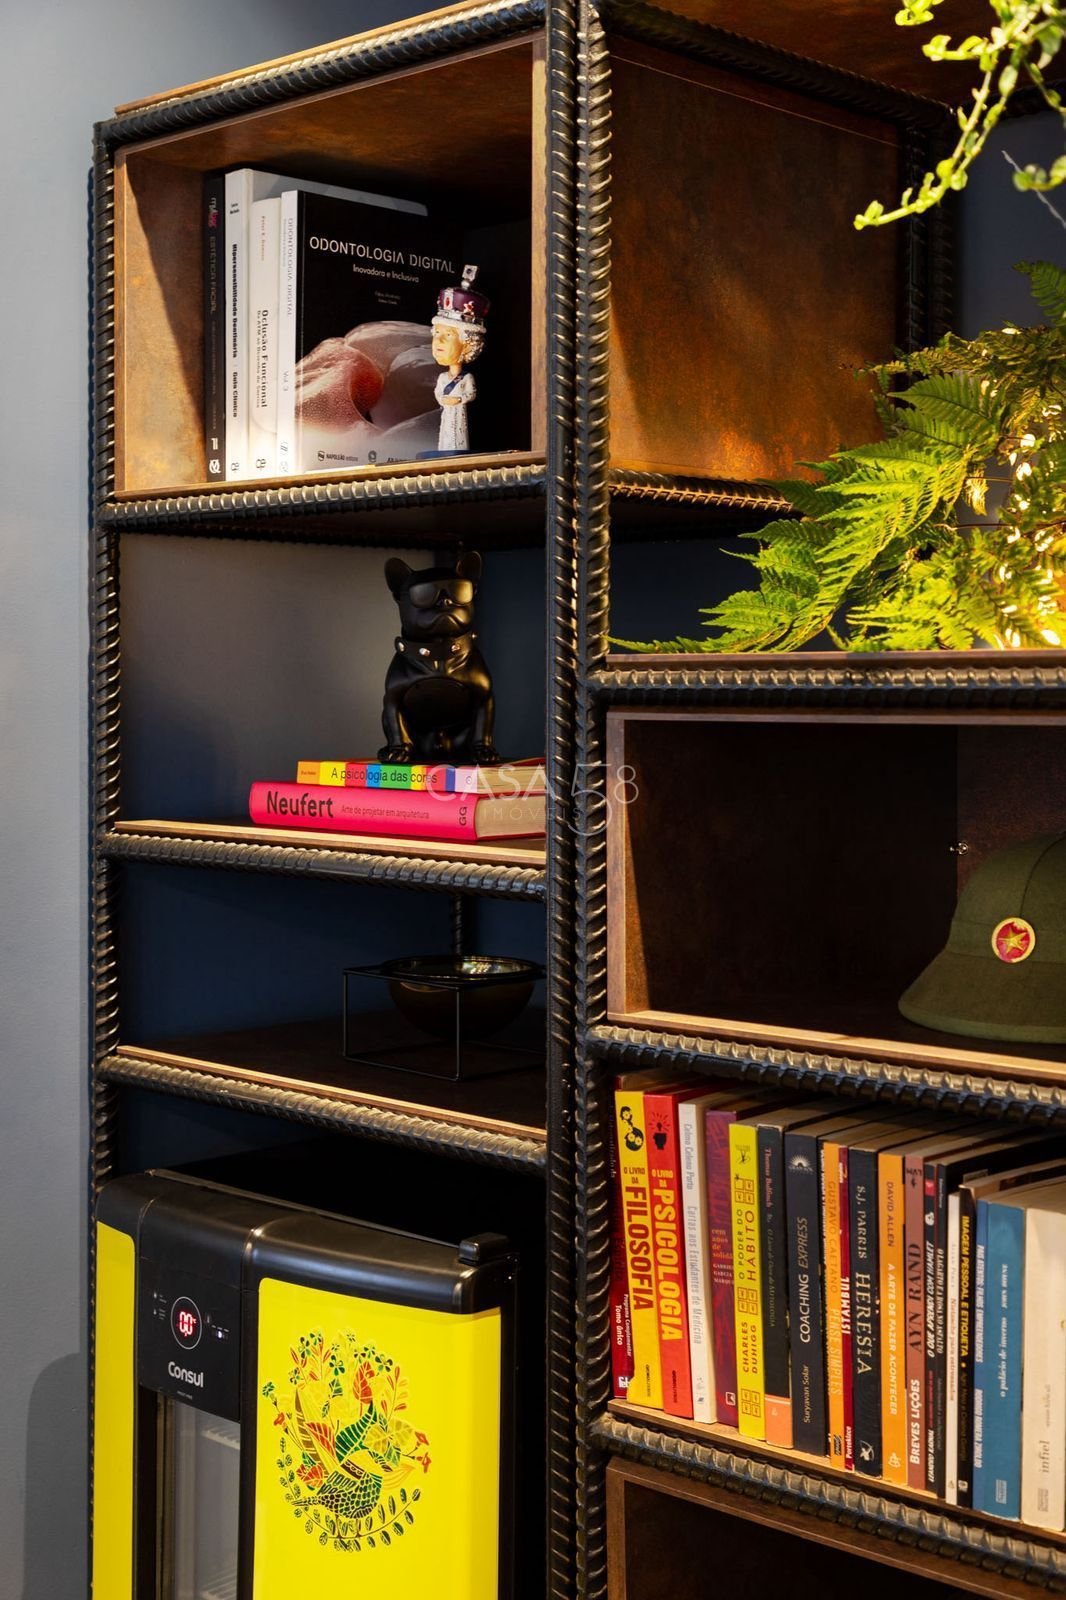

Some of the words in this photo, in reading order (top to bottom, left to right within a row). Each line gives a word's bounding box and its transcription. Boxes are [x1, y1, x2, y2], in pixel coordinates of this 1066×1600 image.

[309, 236, 405, 264] ODONTOLOGIA
[409, 254, 455, 274] DIGITAL
[353, 264, 386, 278] Inovadora
[392, 271, 420, 283] Inclusiva
[261, 309, 269, 352] Oclusão
[261, 354, 269, 408] Funcional
[331, 767, 338, 779] A
[340, 768, 388, 784] psicologia
[390, 769, 408, 782] das
[410, 773, 437, 783] cores
[266, 791, 334, 818] Neufert
[342, 805, 353, 814] Arte
[354, 806, 361, 814] de
[362, 805, 385, 818] projetar
[386, 808, 394, 816] em
[396, 808, 430, 819] arquitetura
[623, 1166, 628, 1175] O
[629, 1167, 646, 1175] LIVRO
[631, 1176, 639, 1185] DA
[651, 1168, 657, 1178] O
[657, 1169, 674, 1179] LIVRO
[827, 1181, 838, 1235] GUSTAVO
[887, 1181, 895, 1212] DAVID
[686, 1206, 698, 1231] Cartas
[736, 1209, 743, 1225] DO
[887, 1214, 896, 1248] ALLEN
[625, 1186, 654, 1311] FILOSOFIA
[688, 1233, 698, 1248] aos
[736, 1230, 744, 1266] PODER
[797, 1216, 808, 1269] EXPRESS
[856, 1210, 868, 1259] PARRIS
[961, 1215, 970, 1255] IMAGEM
[653, 1189, 684, 1341] PSICOLOGIA
[688, 1249, 700, 1294] Estudantes
[828, 1238, 839, 1294] CAETANO
[888, 1262, 898, 1271] A
[907, 1243, 922, 1302] RAND
[925, 1240, 935, 1275] HAMLET
[738, 1271, 745, 1280] O
[887, 1273, 898, 1300] ARTE
[926, 1275, 935, 1295] COM
[960, 1256, 970, 1300] PESSOAL
[615, 1304, 623, 1324] Tomo
[623, 1293, 631, 1318] Programa
[690, 1295, 702, 1306] de
[798, 1273, 811, 1343] COACHING
[888, 1302, 898, 1316] DE
[926, 1295, 935, 1333] APRENDI
[616, 1325, 624, 1347] único
[624, 1318, 633, 1357] Complementar
[691, 1308, 704, 1345] Medicina
[830, 1309, 841, 1342] PENSE
[855, 1271, 874, 1374] HERESIA
[888, 1318, 899, 1351] FAZER
[908, 1311, 922, 1354] AYN
[960, 1309, 969, 1357] ETIQUETA
[998, 1316, 1008, 1348] inverno
[740, 1322, 750, 1373] CHARLES
[748, 1324, 758, 1374] DUHIGG
[926, 1332, 935, 1350] QUE
[926, 1350, 935, 1359] O
[998, 1348, 1008, 1360] de
[168, 1361, 204, 1388] Consul
[801, 1364, 810, 1385] Solar
[830, 1346, 842, 1394] SIMPLES
[888, 1353, 899, 1416] ACONTECER
[997, 1360, 1009, 1391] palácio
[803, 1386, 812, 1423] Suryavan
[1038, 1439, 1051, 1474] infiel
